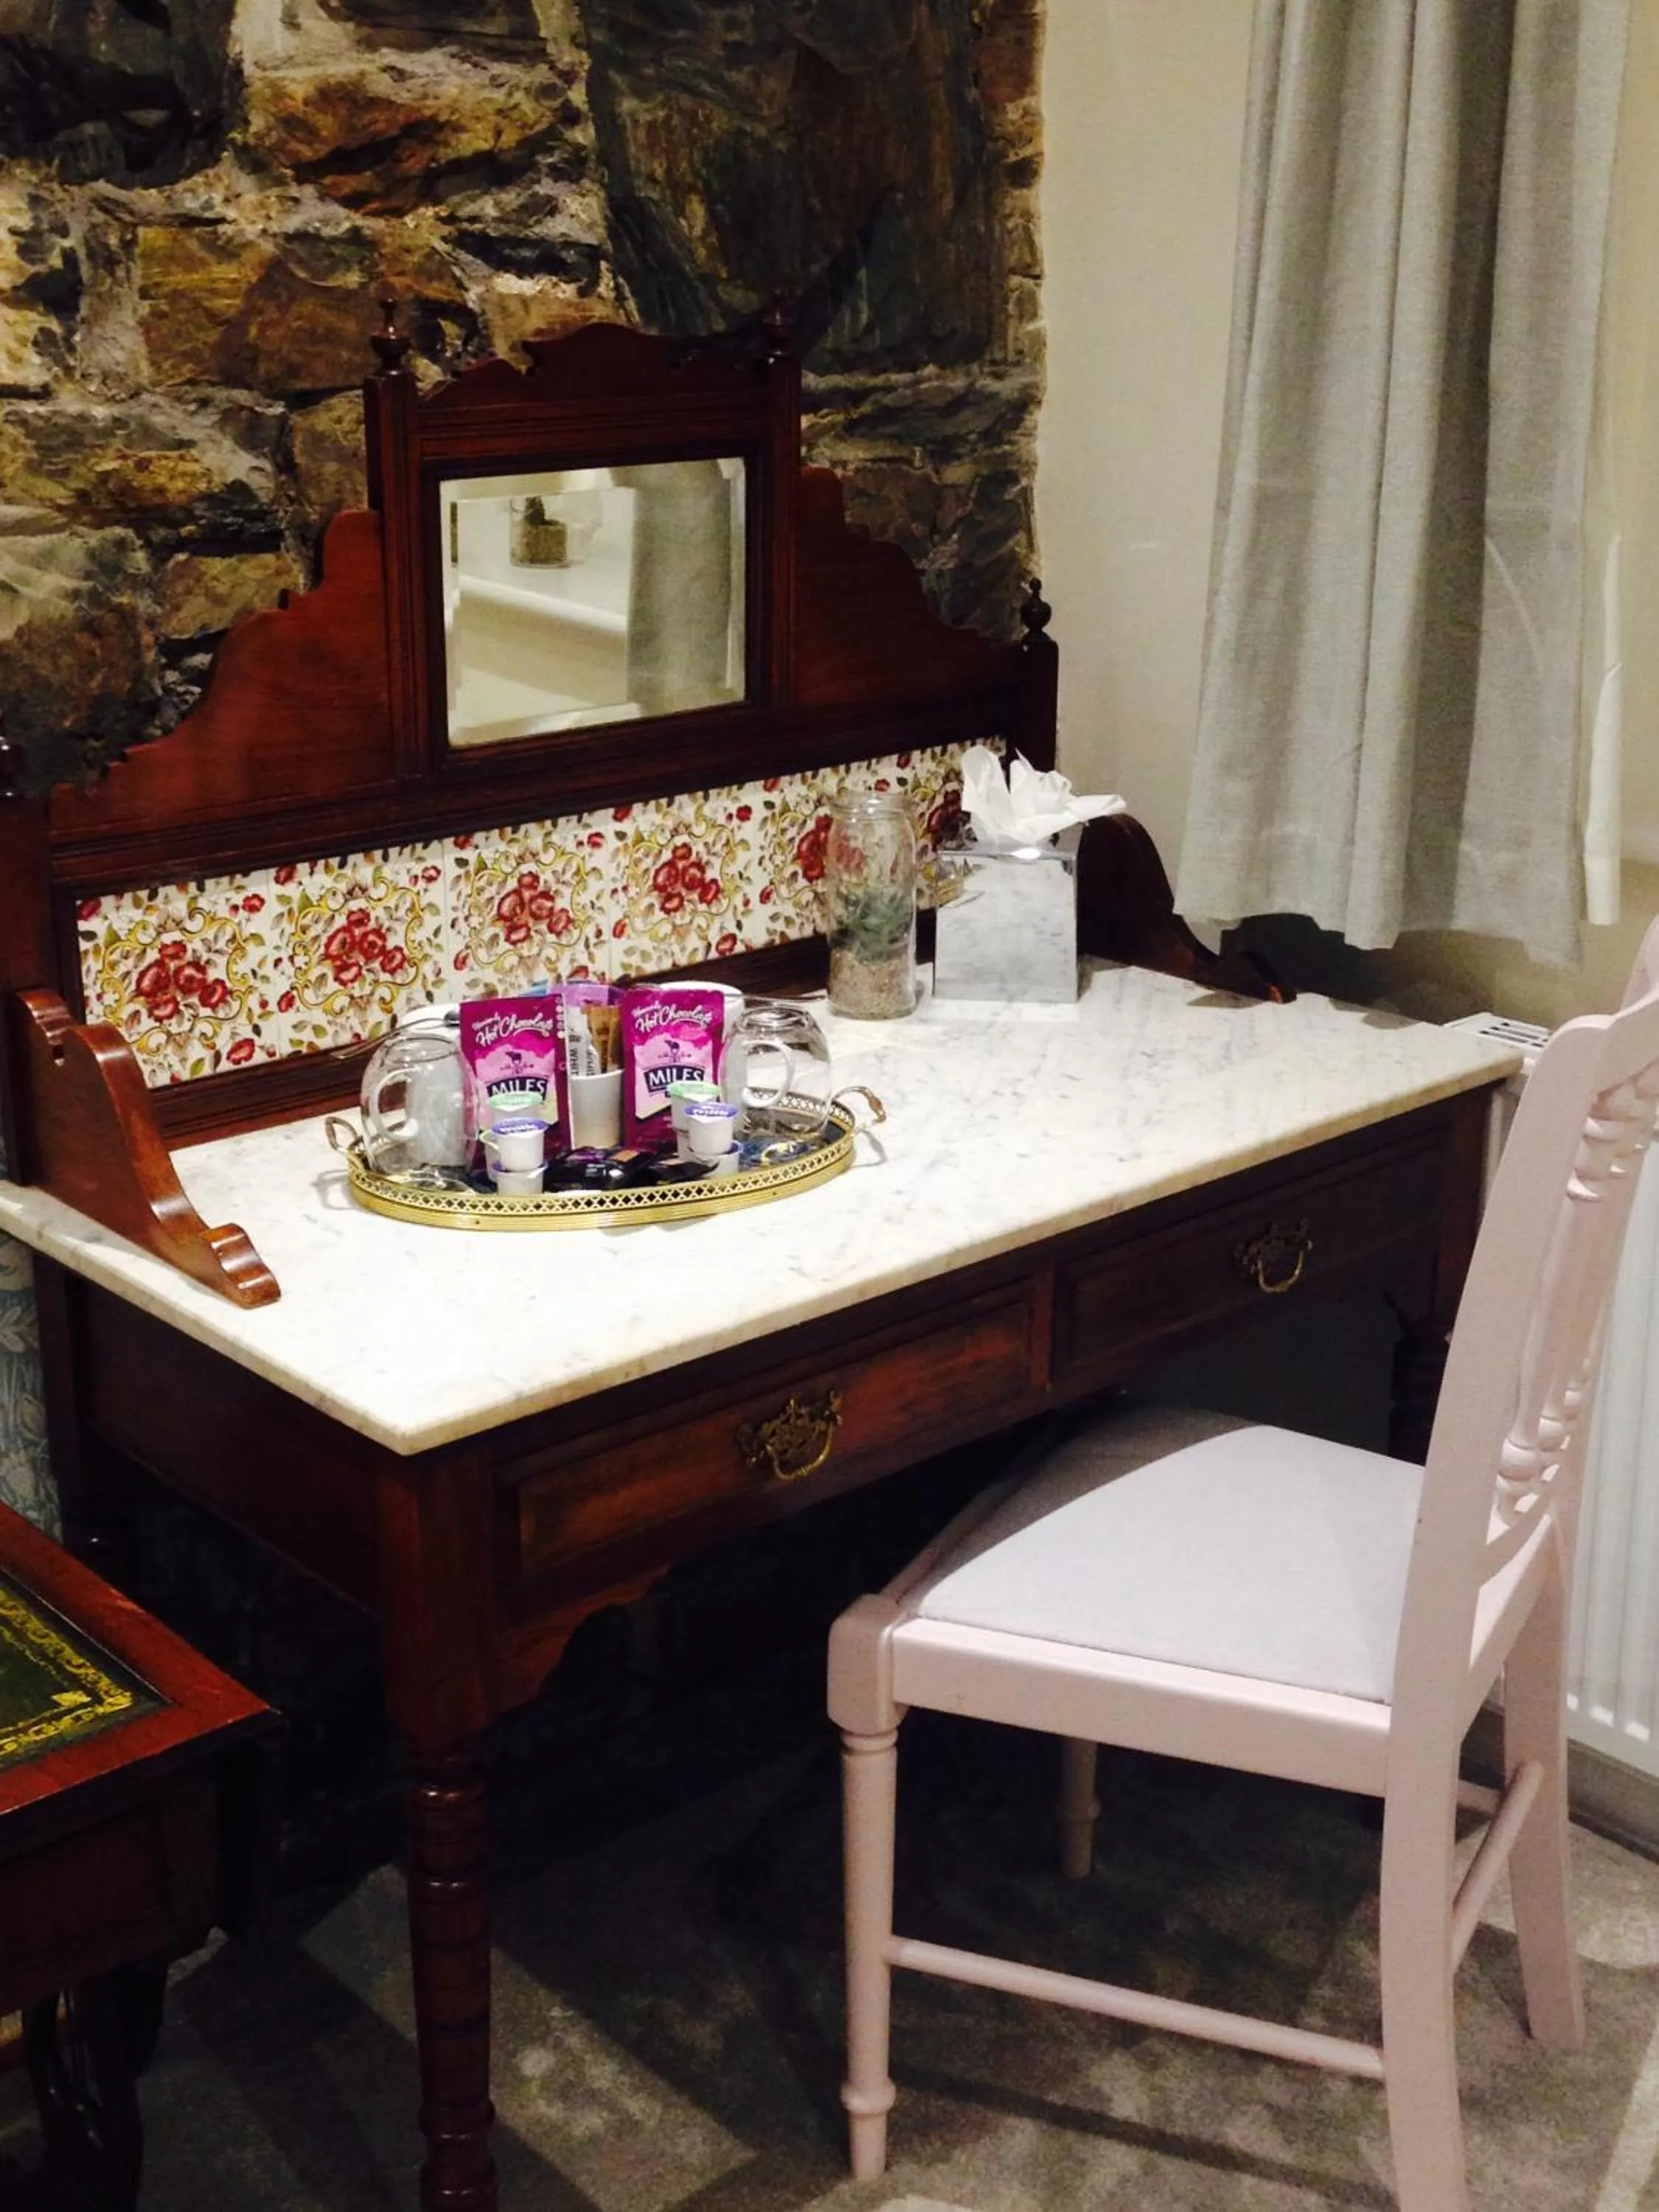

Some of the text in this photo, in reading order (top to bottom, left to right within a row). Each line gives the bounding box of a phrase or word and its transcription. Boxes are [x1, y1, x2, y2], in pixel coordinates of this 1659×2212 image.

[635, 1012, 659, 1033] Hot
[476, 1023, 499, 1047] Hot
[649, 1066, 703, 1086] MILES
[491, 1078, 546, 1095] MILES
